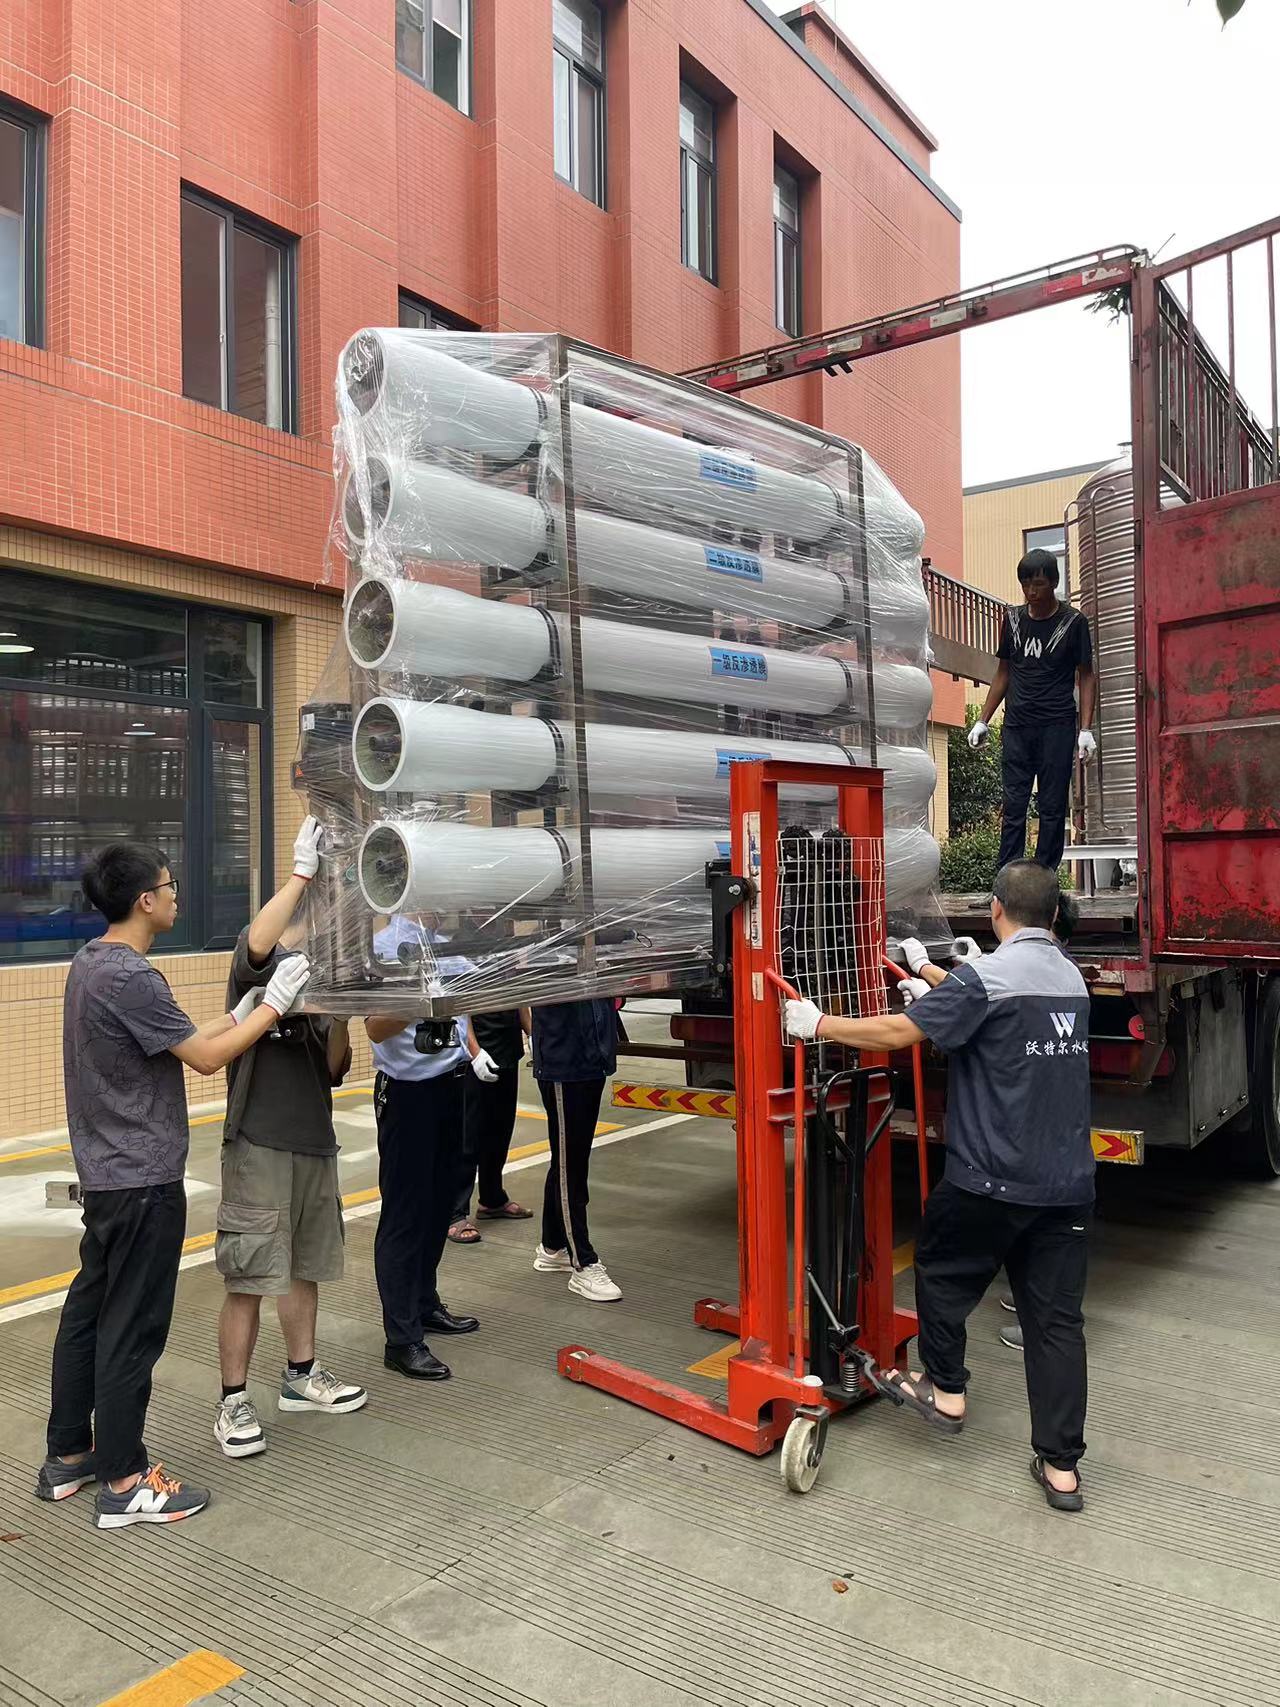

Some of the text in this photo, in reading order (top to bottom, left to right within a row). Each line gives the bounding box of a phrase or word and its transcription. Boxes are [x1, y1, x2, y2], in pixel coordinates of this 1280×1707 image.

[713, 653, 767, 675] 一级反渗透膜
